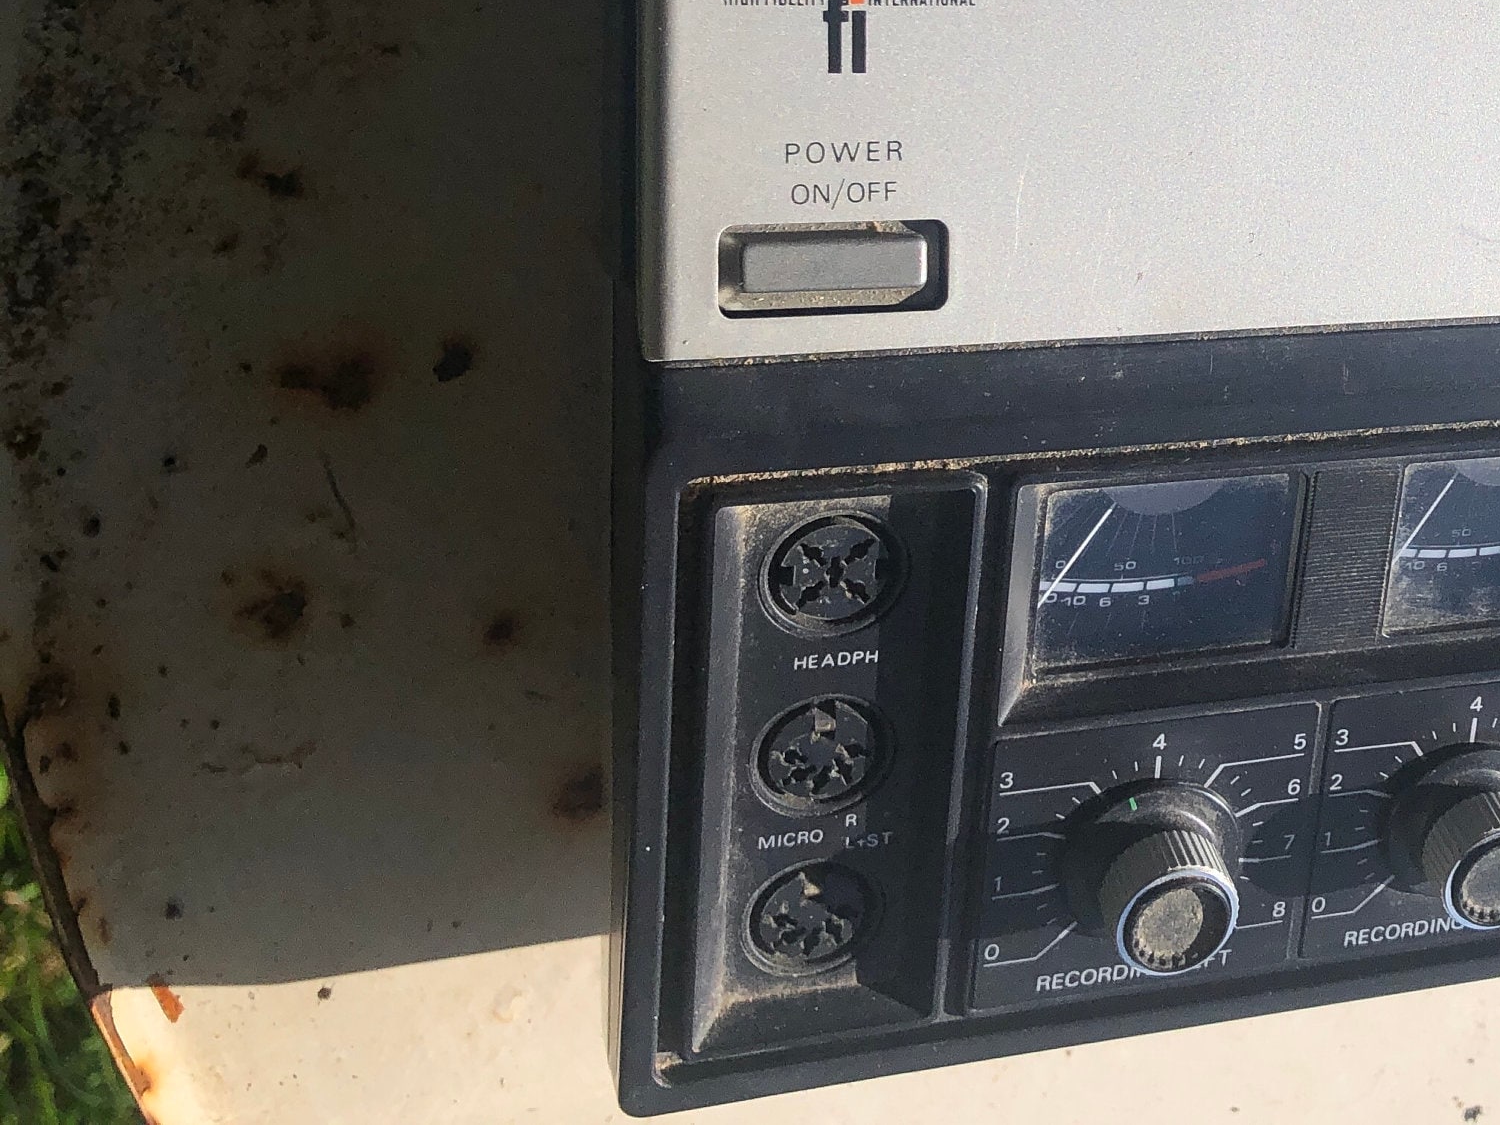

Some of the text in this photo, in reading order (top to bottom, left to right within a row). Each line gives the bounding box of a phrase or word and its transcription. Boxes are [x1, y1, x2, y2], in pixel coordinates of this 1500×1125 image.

[784, 140, 904, 164] POWER
[790, 178, 898, 210] ON/OFF
[1451, 528, 1472, 537] 50
[1114, 560, 1137, 571] 50
[1099, 596, 1111, 607] 6
[1138, 594, 1150, 605] 3
[793, 650, 879, 671] HEADPH
[1470, 696, 1483, 712] 4
[1152, 733, 1167, 750] 4
[1293, 733, 1307, 750] 5
[1335, 729, 1349, 745] 3
[999, 772, 1014, 789] 3
[1287, 778, 1301, 795] 6
[1328, 774, 1343, 790] 2
[845, 813, 857, 828] R
[996, 817, 1010, 834] 2
[757, 829, 824, 850] MICRO
[1284, 834, 1296, 850] 7
[1272, 901, 1286, 918] 8
[1311, 897, 1326, 913] 0
[984, 944, 1000, 961] 0
